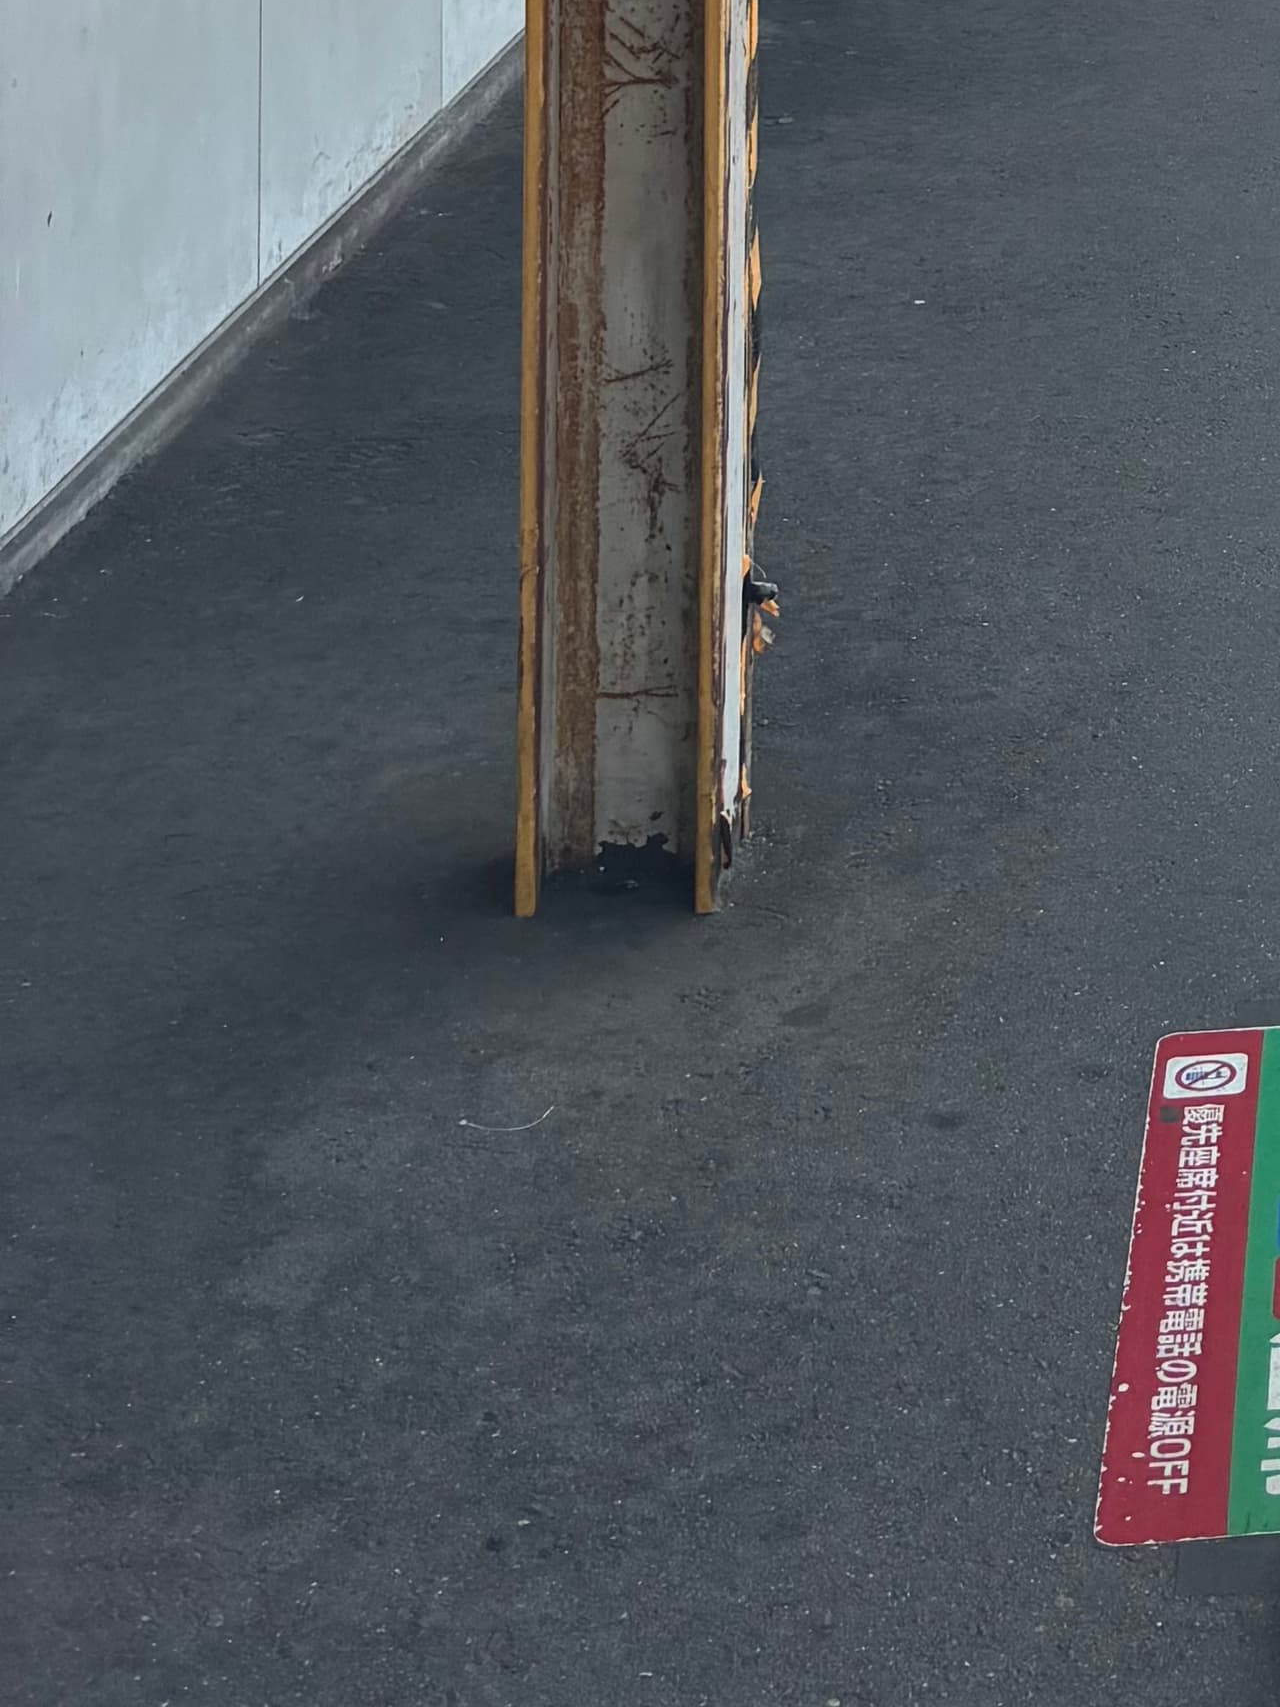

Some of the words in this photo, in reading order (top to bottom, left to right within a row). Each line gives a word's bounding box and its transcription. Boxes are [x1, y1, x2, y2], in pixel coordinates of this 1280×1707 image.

[1148, 1104, 1226, 1496] 優先座席付近は携帯電話の電源OFF
